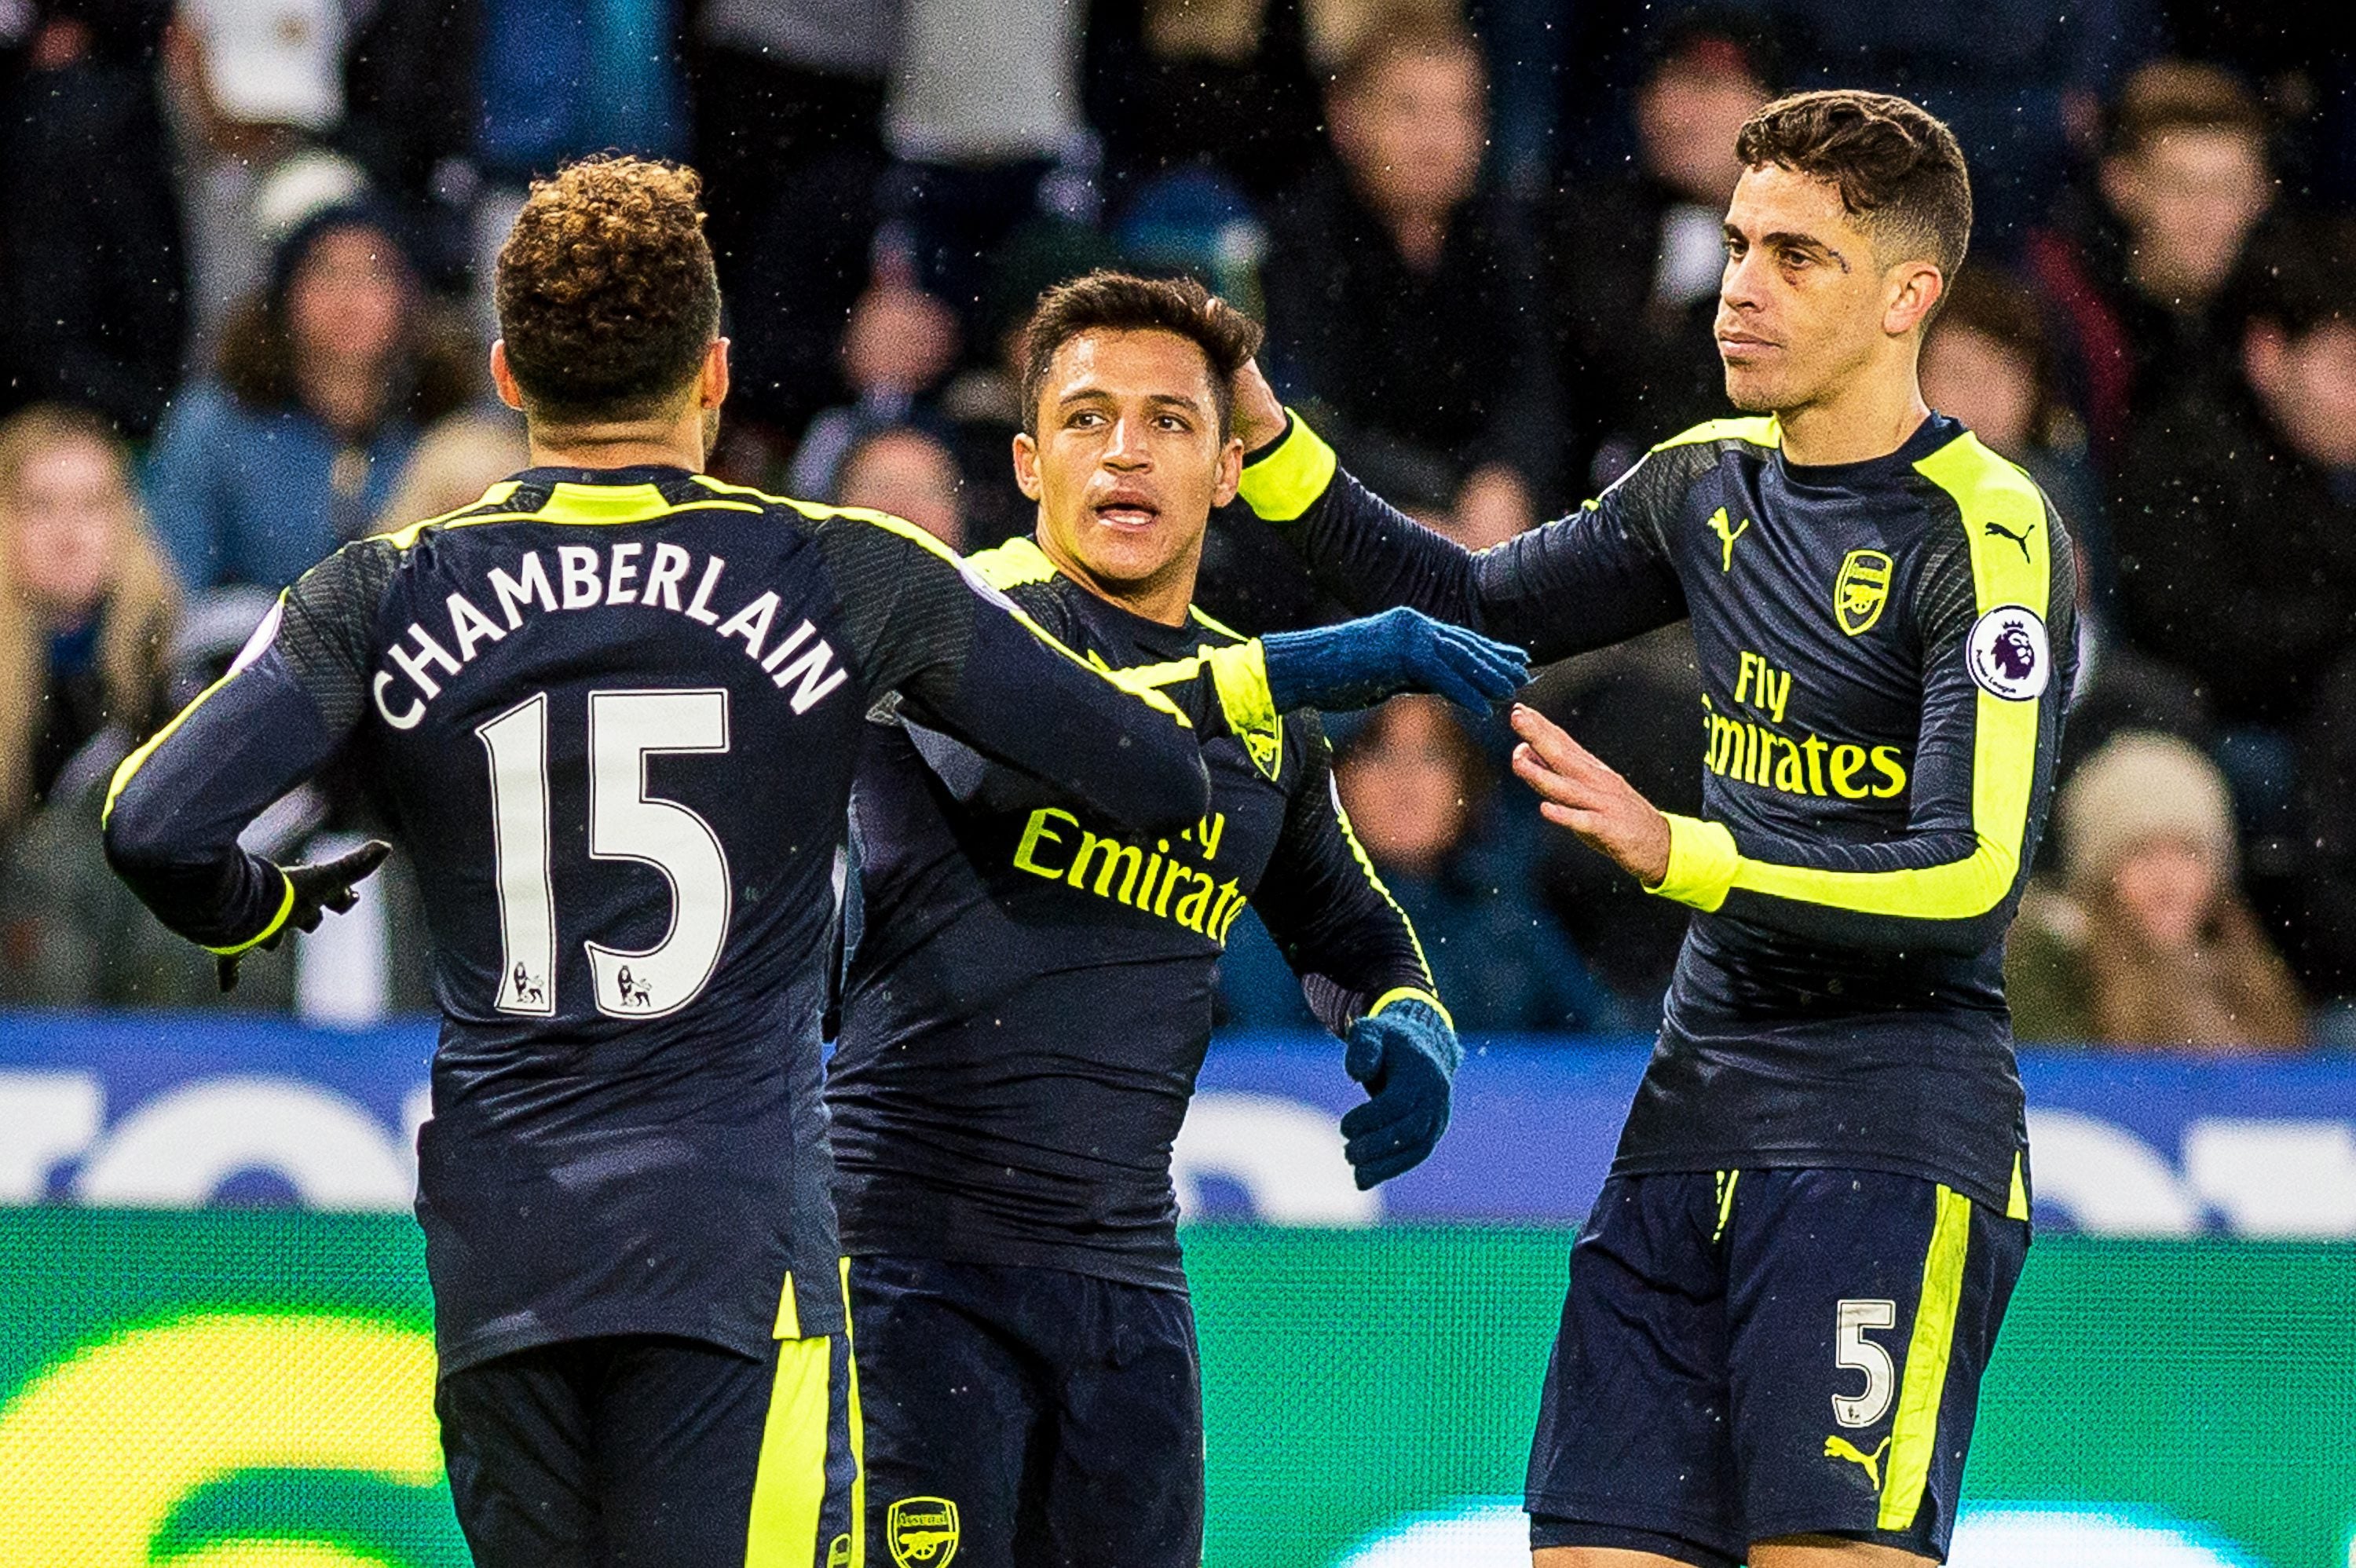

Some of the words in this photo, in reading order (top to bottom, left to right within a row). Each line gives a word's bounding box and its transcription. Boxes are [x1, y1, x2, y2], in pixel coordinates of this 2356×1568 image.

[372, 542, 848, 730] CHAMBERLAIN
[1734, 651, 1791, 722] Fly
[1701, 693, 1907, 799] mirates
[475, 688, 731, 1018] 15
[1013, 807, 1247, 951] Emirate
[1831, 1299, 1896, 1428] 5
